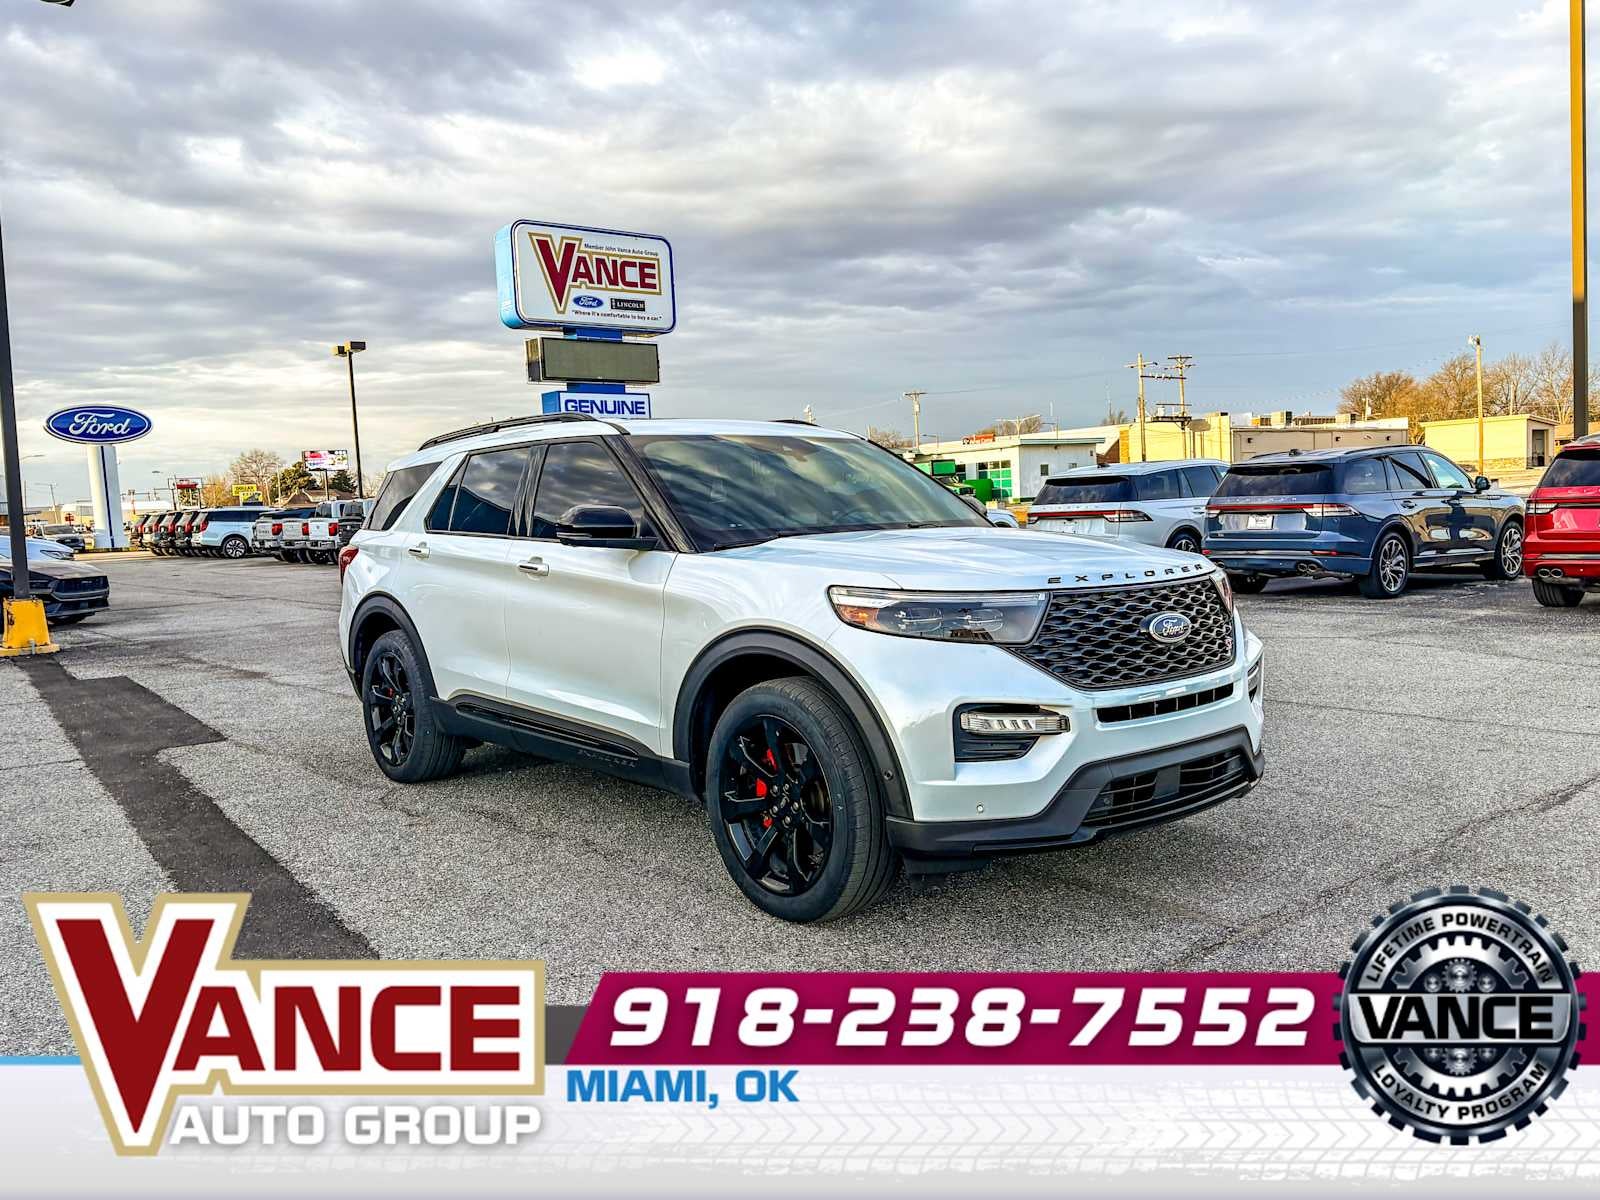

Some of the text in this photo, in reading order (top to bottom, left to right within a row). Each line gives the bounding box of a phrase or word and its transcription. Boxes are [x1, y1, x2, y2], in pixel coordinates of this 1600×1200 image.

[644, 249, 658, 257] Group
[535, 238, 657, 305] VANCE
[578, 296, 598, 306] Ford
[600, 311, 630, 319] comfortable
[564, 399, 645, 415] GENUINE
[69, 411, 130, 436] Ford
[1048, 564, 1203, 584] EXPLORER
[1162, 619, 1185, 636] Ford
